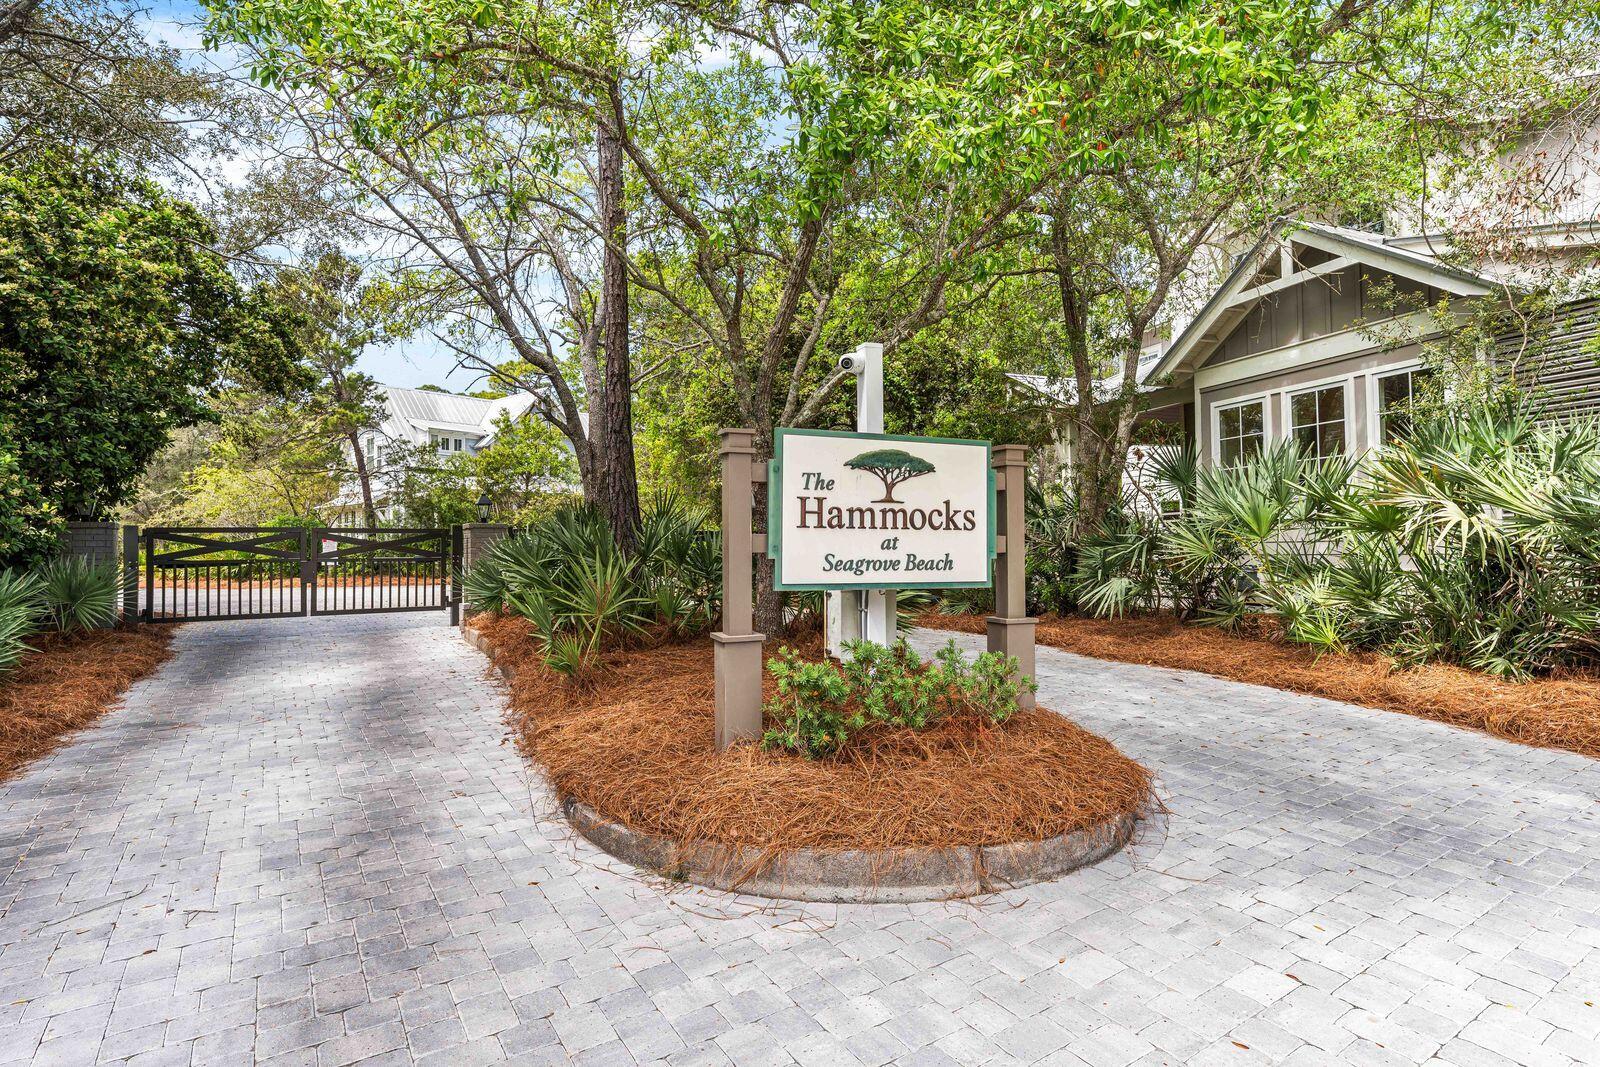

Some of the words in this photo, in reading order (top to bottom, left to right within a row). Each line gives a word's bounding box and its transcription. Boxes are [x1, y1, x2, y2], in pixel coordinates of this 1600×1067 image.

[802, 472, 835, 491] The
[796, 496, 976, 531] Hammocks
[880, 536, 899, 550] at
[822, 553, 900, 576] Seagrove
[904, 553, 954, 571] Beach
